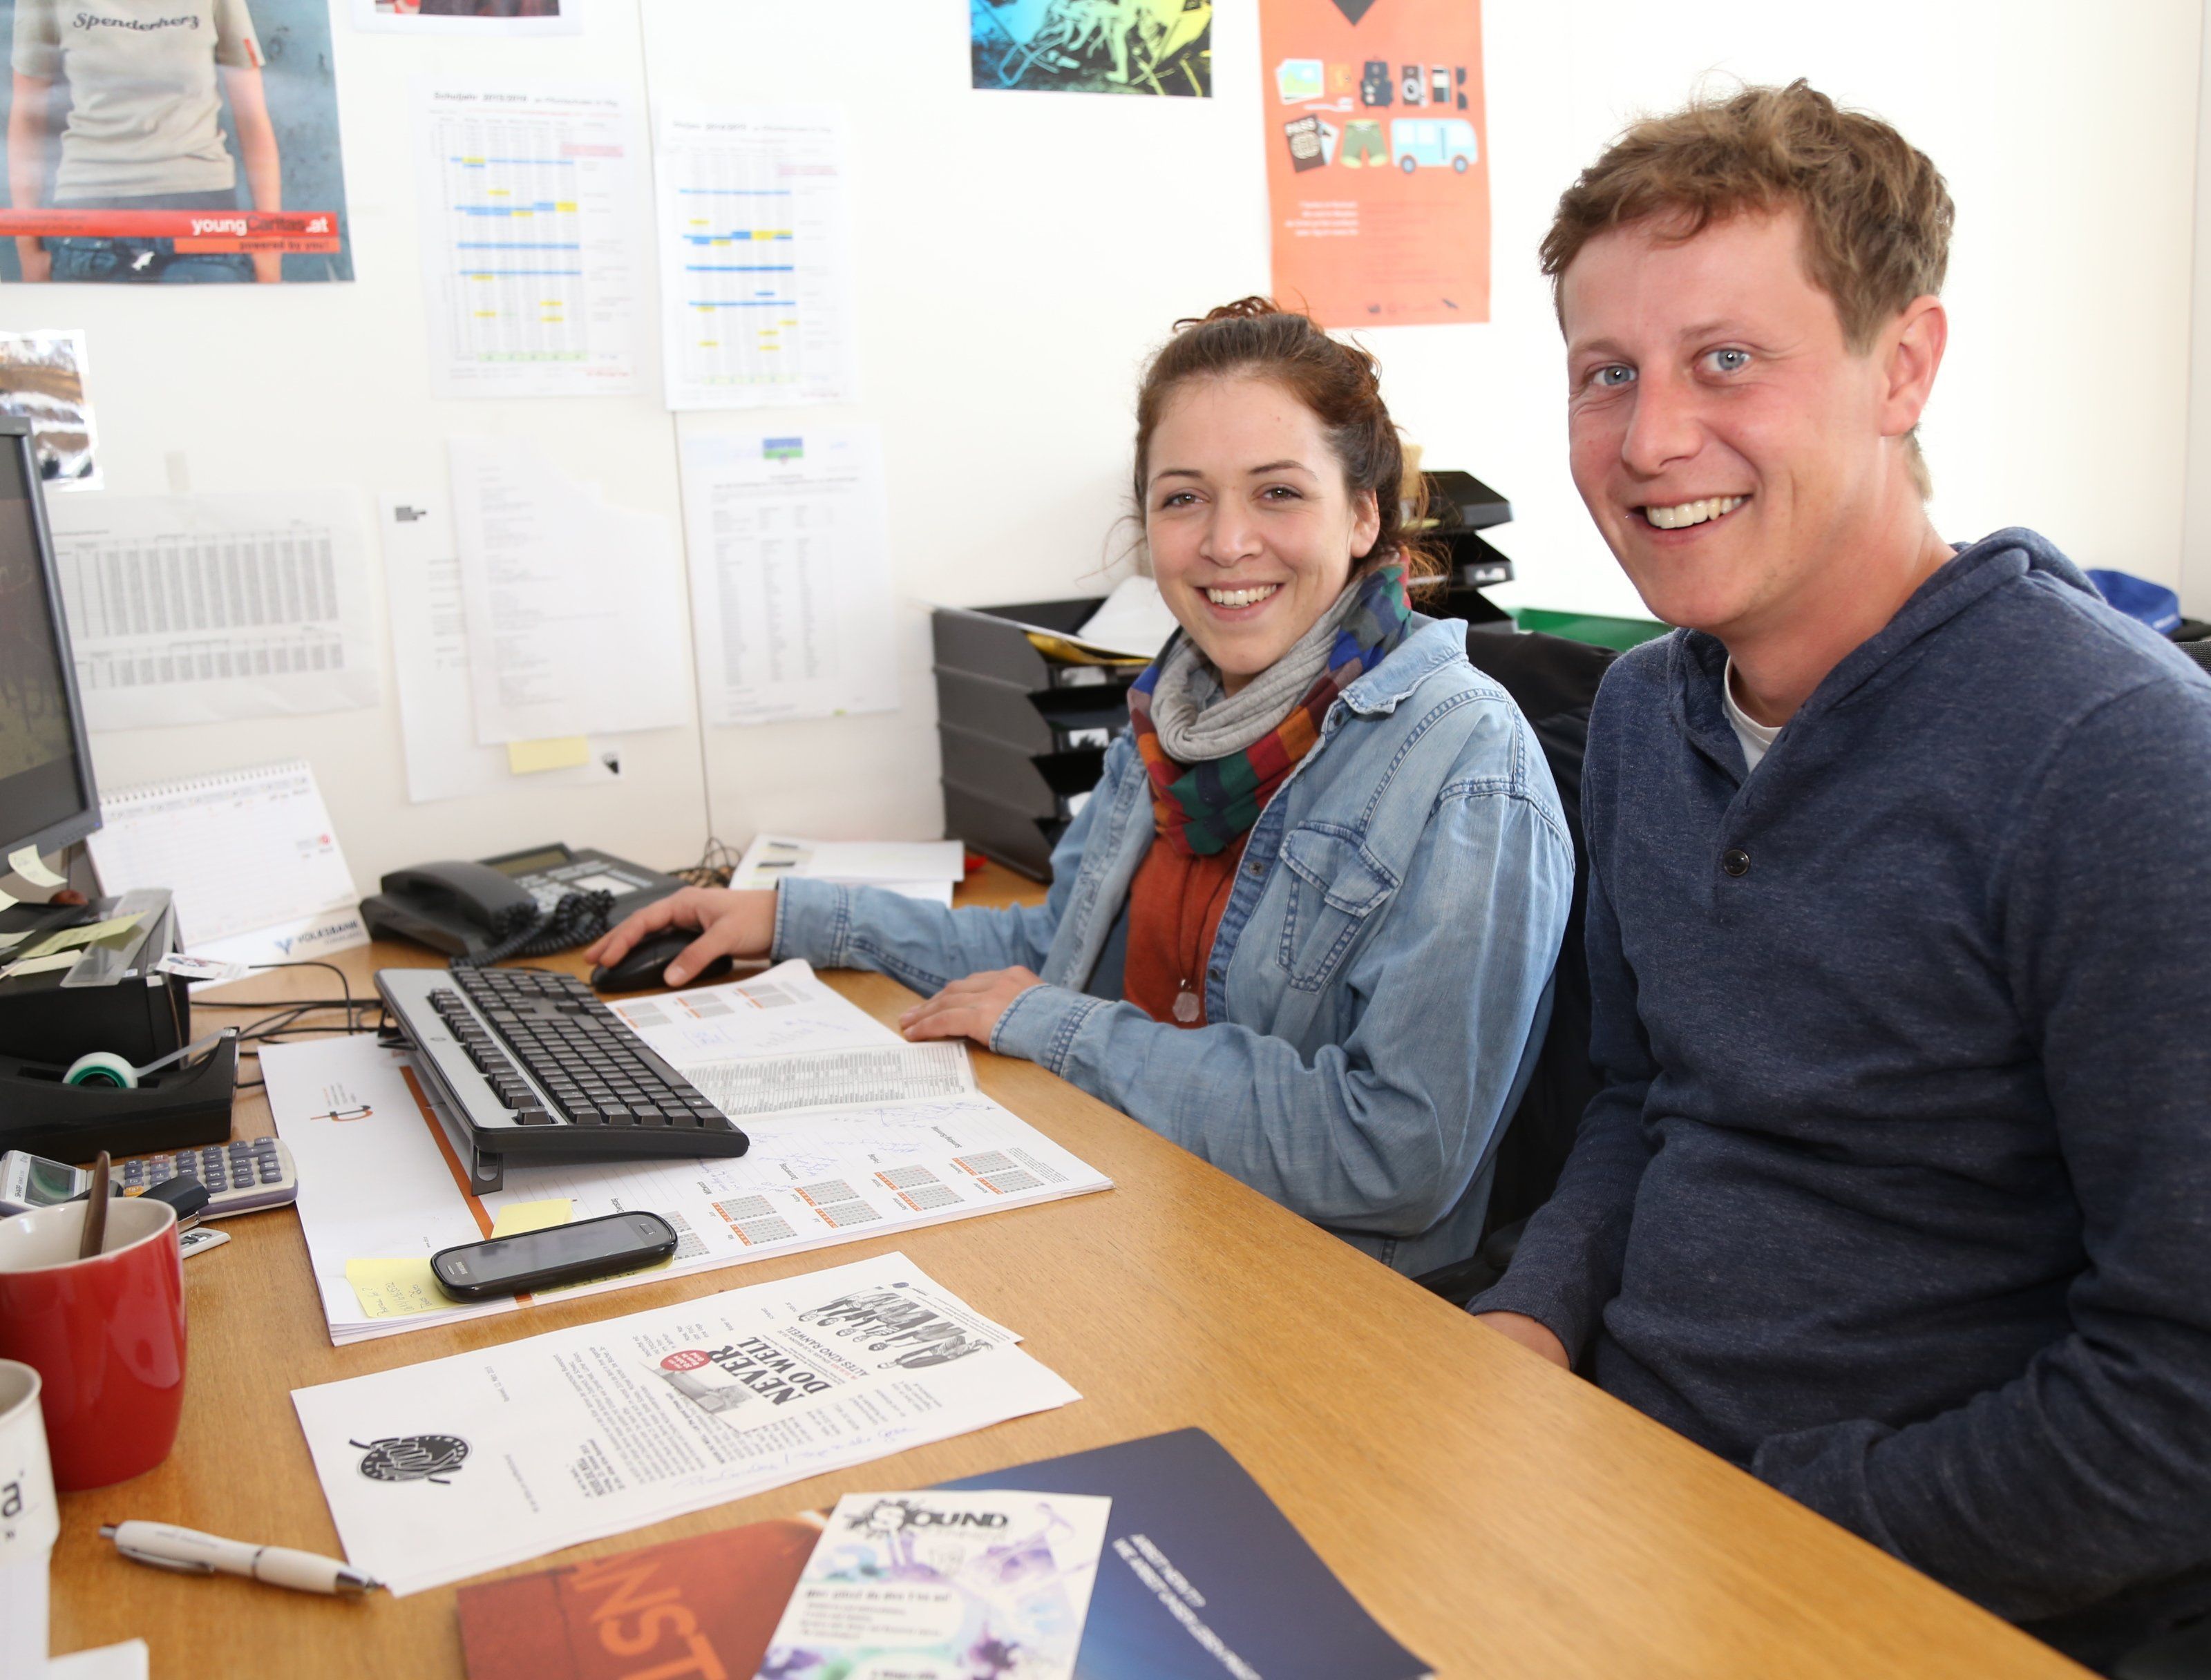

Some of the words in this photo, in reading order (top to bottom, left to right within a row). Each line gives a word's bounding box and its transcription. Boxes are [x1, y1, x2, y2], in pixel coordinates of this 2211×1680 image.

[73, 11, 200, 32] Spenderherz
[930, 1125, 962, 1149] Samstag/Sonntag
[867, 1154, 882, 1164] Freitag
[779, 1163, 799, 1181] Donnerstag
[696, 1181, 713, 1195] Mittwoch
[610, 1198, 625, 1214] Dienstag
[455, 1261, 468, 1275] SAMSUNG
[737, 1336, 795, 1374] WELL
[819, 1348, 845, 1364] KINO
[706, 1345, 804, 1405] NEVER
[841, 1361, 870, 1377] ALTES
[788, 1372, 833, 1394] DO
